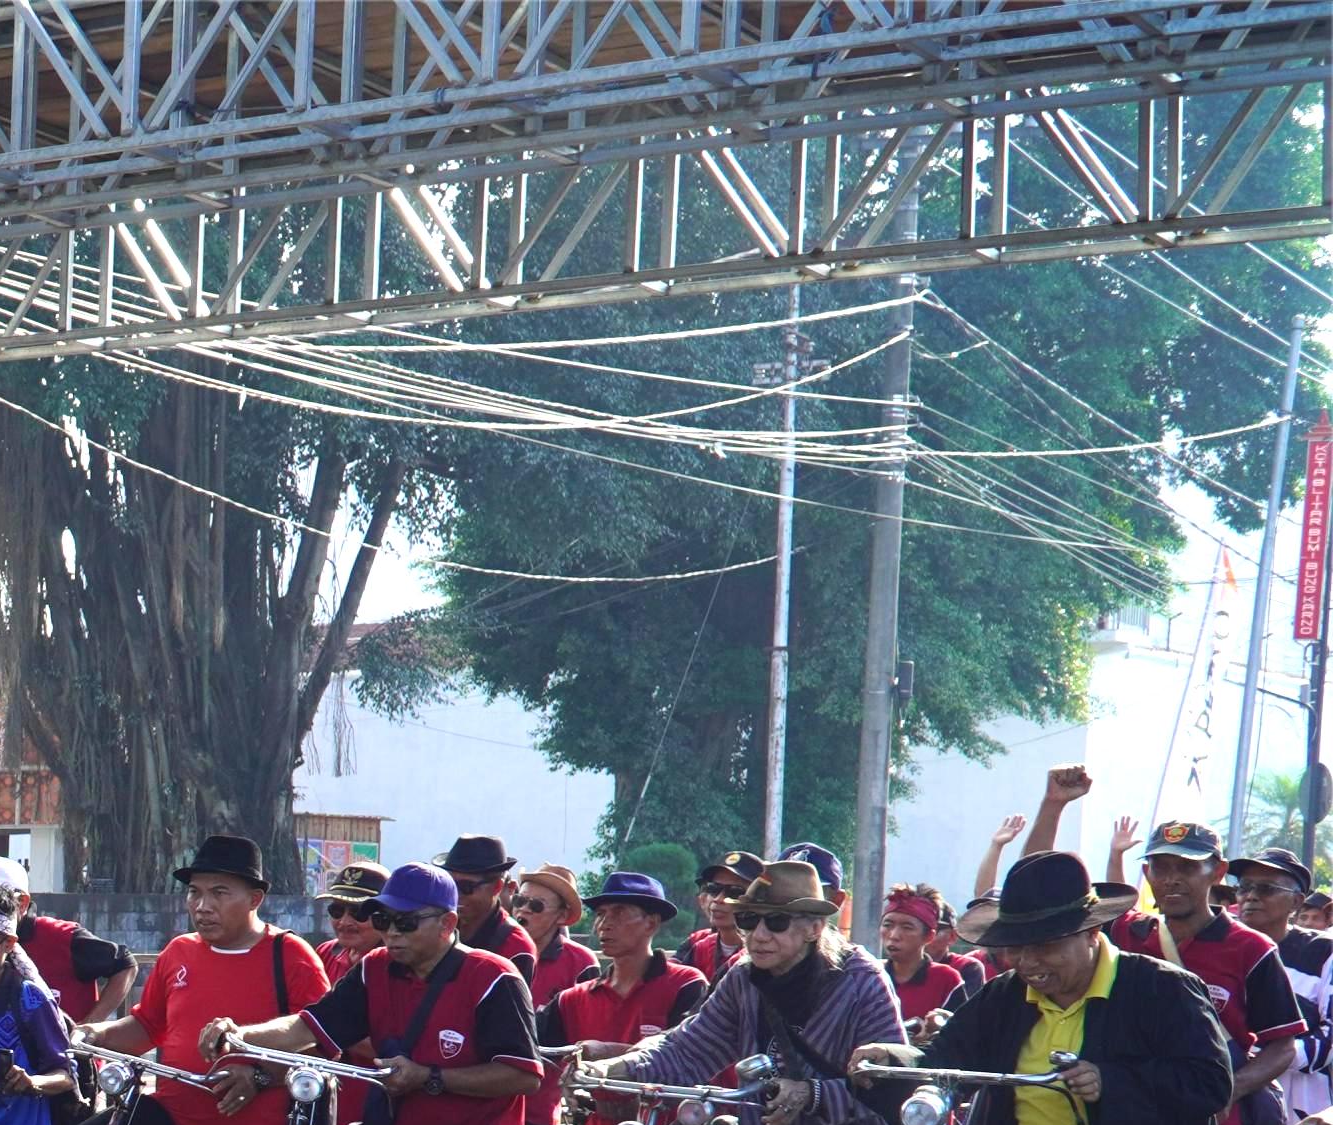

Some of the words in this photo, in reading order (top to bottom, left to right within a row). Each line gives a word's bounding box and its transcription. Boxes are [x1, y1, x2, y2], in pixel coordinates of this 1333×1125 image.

[1313, 444, 1330, 476] KOTA
[1309, 479, 1325, 525] BLITAR
[1307, 528, 1321, 559] BUMI
[1303, 562, 1318, 594] BUNG
[1300, 596, 1315, 635] KARNO
